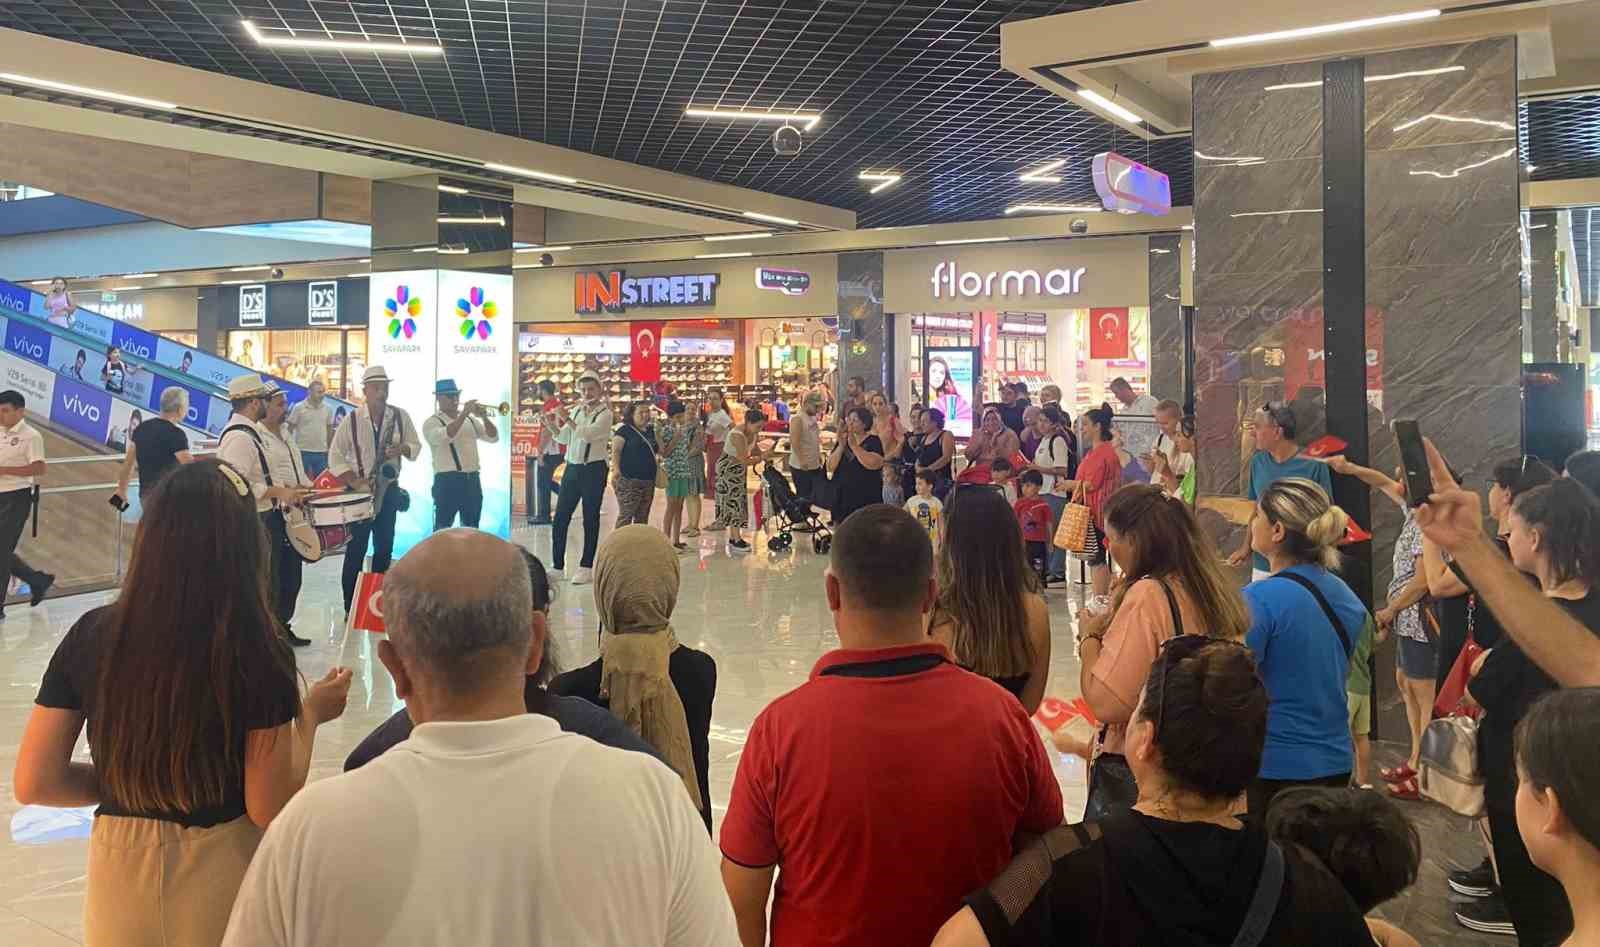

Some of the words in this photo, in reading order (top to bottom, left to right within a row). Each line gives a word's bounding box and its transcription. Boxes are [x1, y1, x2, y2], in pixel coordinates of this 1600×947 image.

[931, 261, 1086, 297] flormar
[0, 293, 24, 312] vivo
[13, 336, 43, 358] vivo
[120, 337, 150, 358] vivo
[63, 394, 100, 422] vivo
